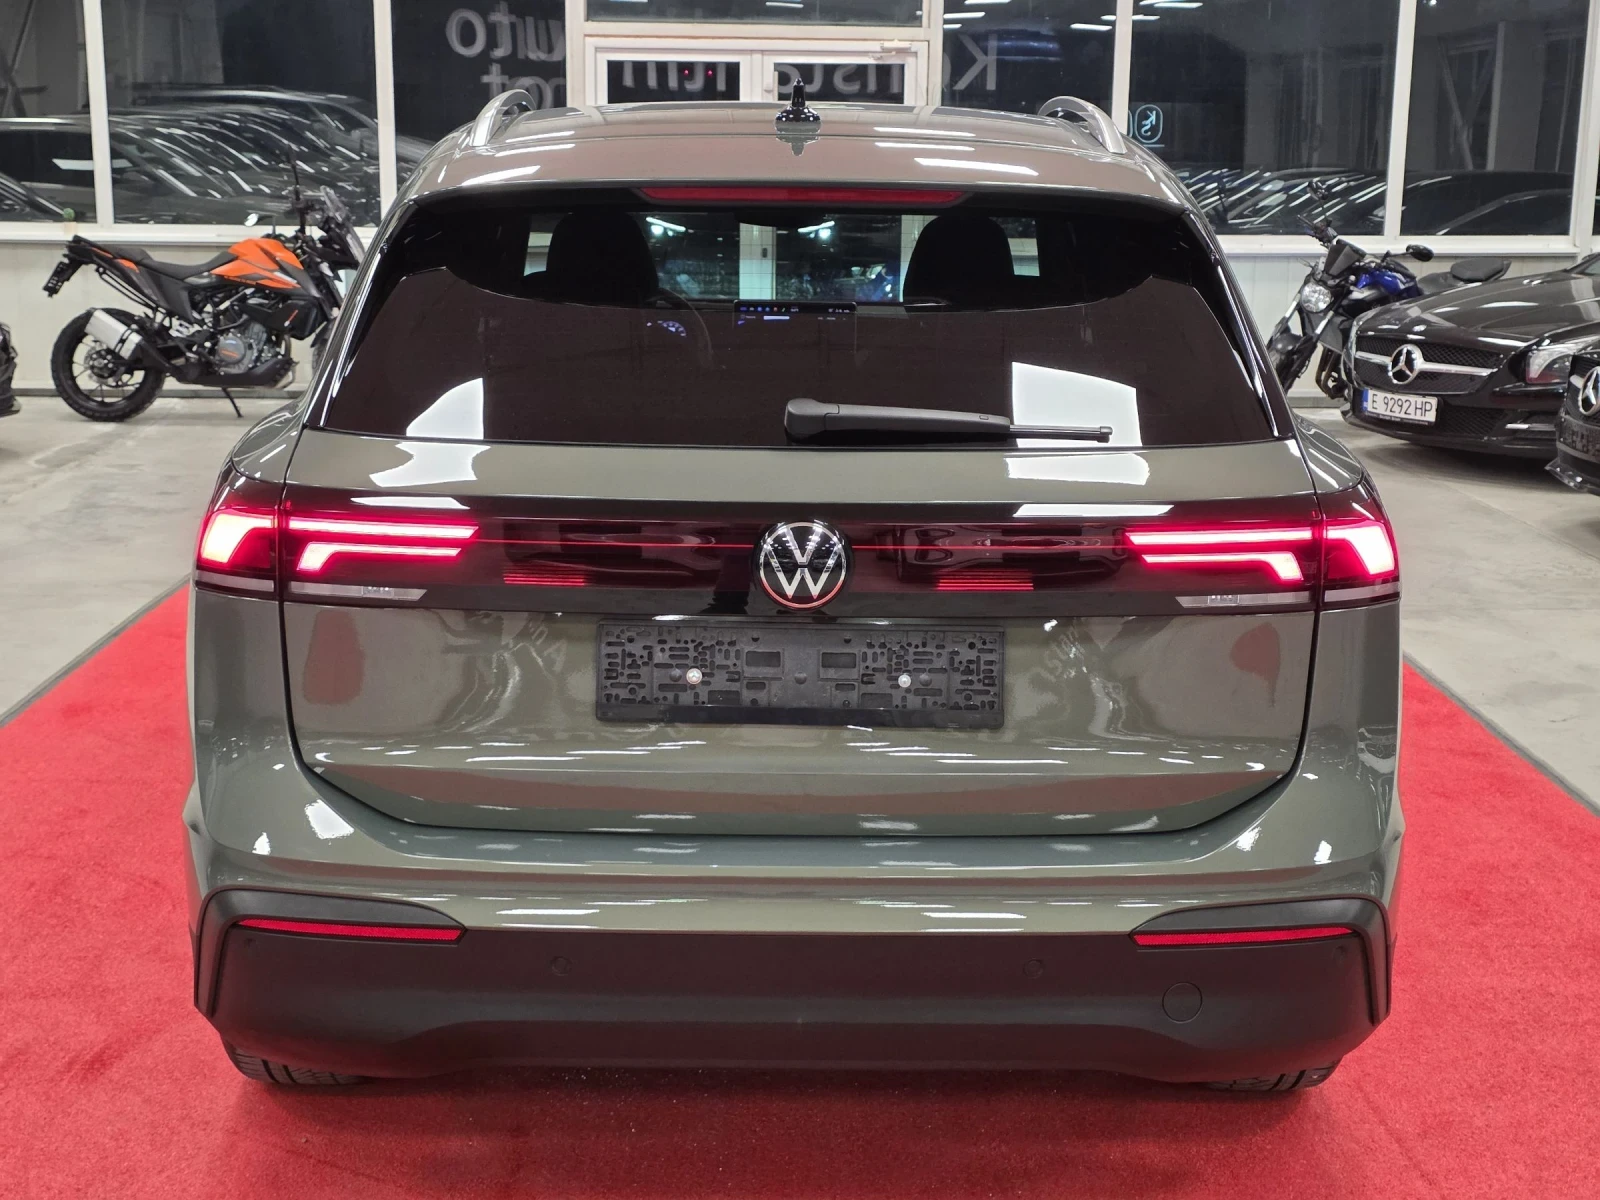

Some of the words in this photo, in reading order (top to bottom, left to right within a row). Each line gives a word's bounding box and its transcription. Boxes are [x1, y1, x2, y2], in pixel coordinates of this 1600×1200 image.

[1371, 393, 1379, 411] E
[1383, 396, 1412, 416] 9292
[1414, 399, 1433, 418] HP
[762, 524, 843, 602] VW
